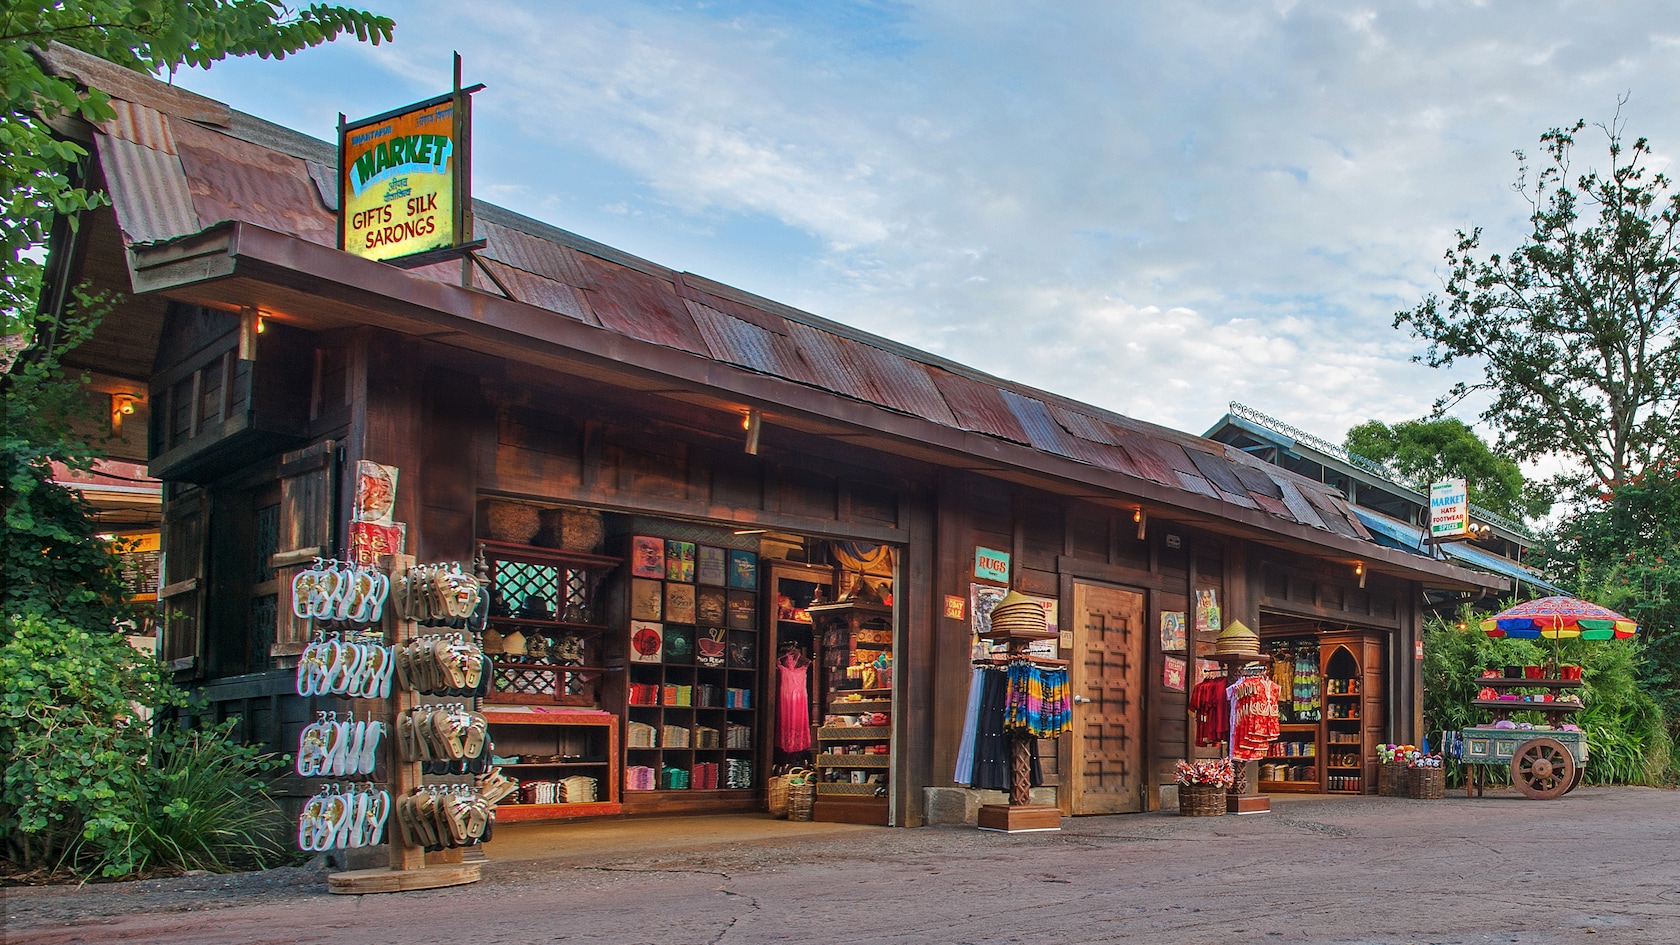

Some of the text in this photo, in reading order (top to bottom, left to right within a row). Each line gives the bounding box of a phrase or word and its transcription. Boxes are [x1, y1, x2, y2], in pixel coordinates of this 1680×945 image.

[354, 134, 449, 186] MARKET
[352, 204, 393, 230] GIFTS
[407, 192, 438, 217] SILK
[365, 215, 436, 249] SARONGS
[1431, 493, 1465, 508] MARKET
[1440, 506, 1457, 514] HATS
[1433, 514, 1464, 523] FOOTWEAR
[978, 555, 1007, 574] RUGS
[945, 598, 964, 610] TODAY
[946, 608, 962, 618] SALE
